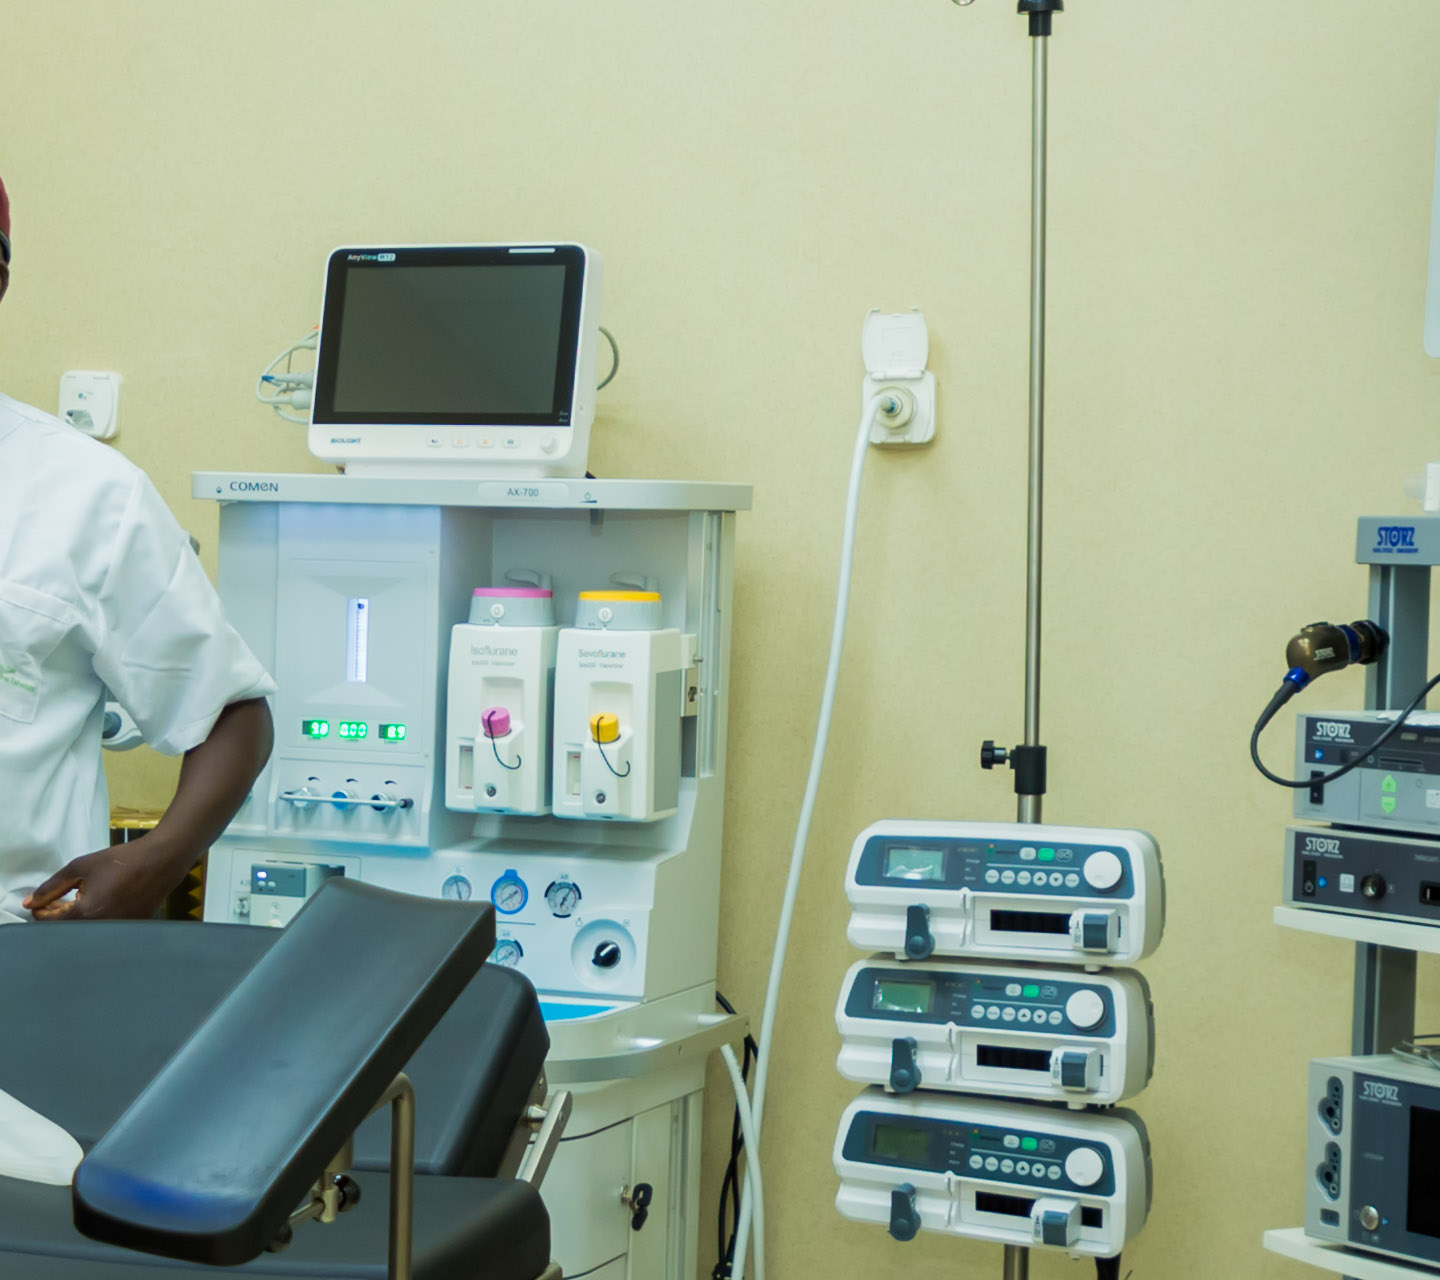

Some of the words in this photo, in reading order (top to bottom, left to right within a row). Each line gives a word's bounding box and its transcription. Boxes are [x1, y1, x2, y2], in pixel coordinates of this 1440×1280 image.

[506, 486, 540, 497] AX-700
[1377, 525, 1416, 548] STORZ
[470, 644, 518, 657] Isoflurane
[578, 648, 626, 659] Sevoflurane
[1316, 721, 1352, 739] STORZ
[1304, 836, 1340, 854] STORZ
[1363, 1080, 1399, 1101] STORZ
